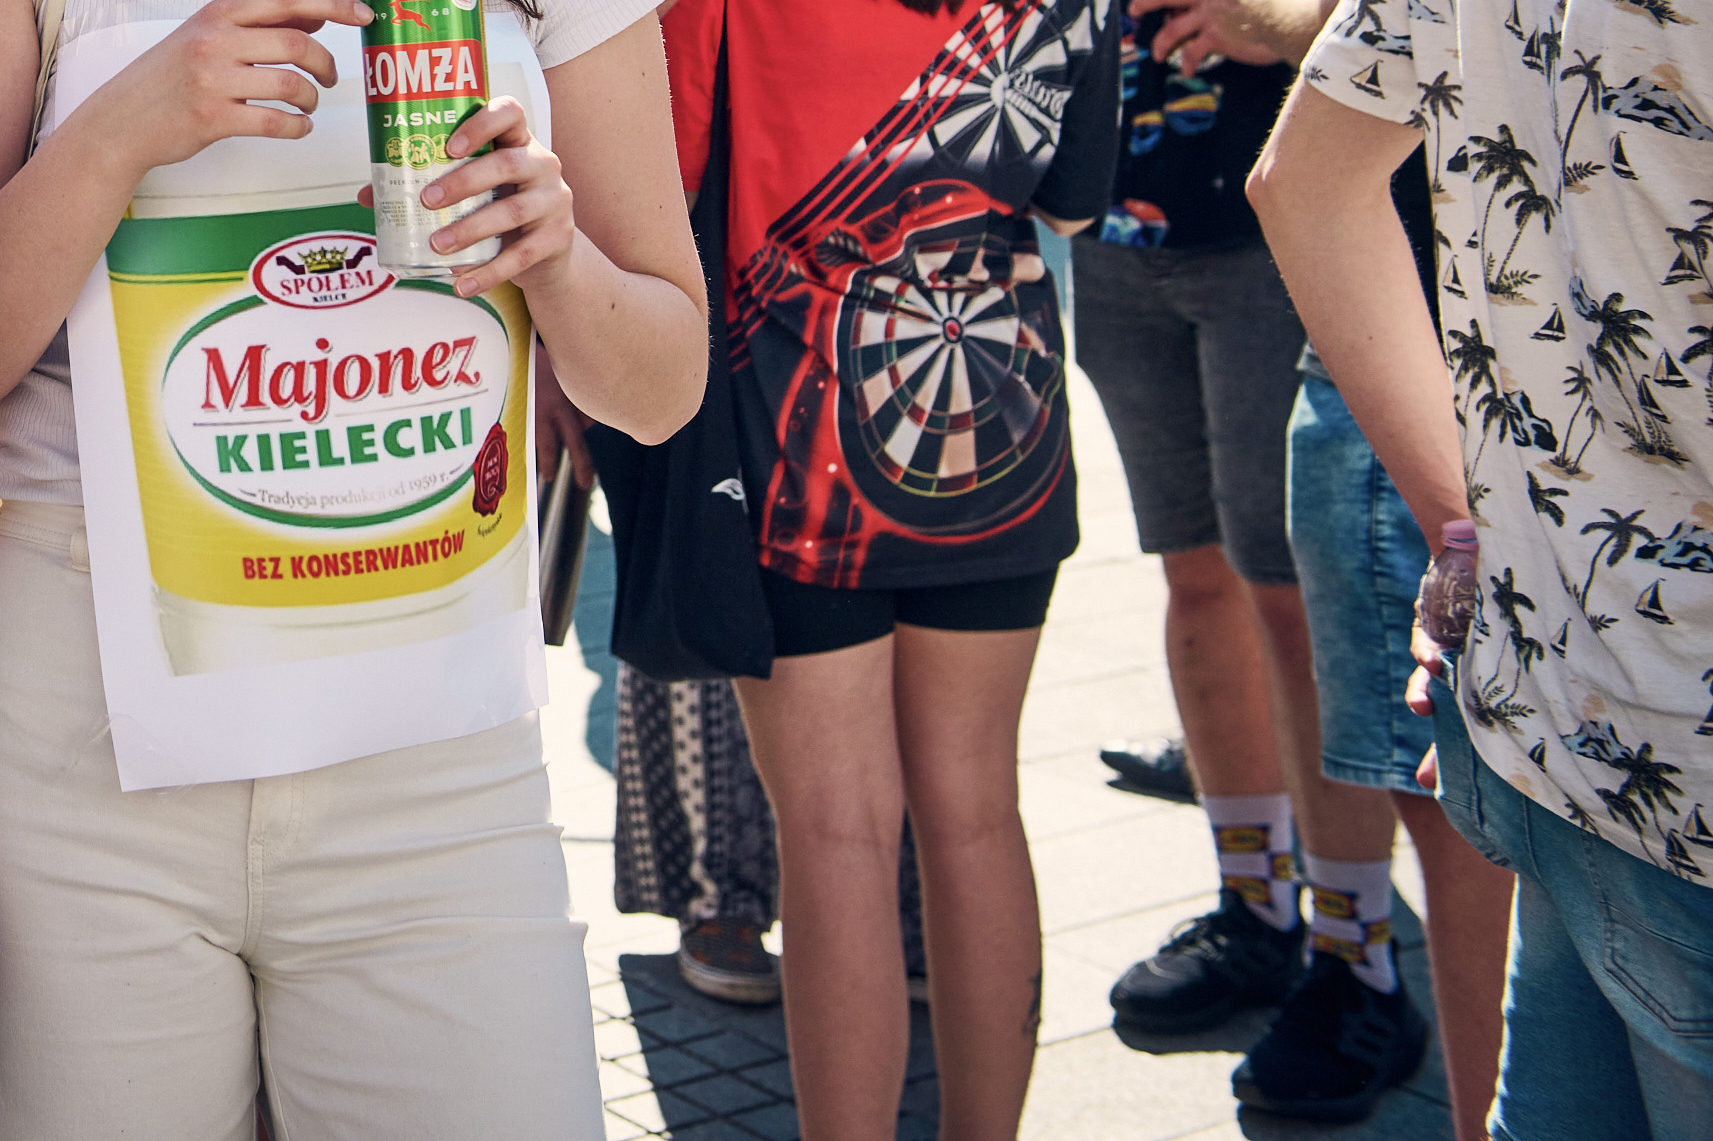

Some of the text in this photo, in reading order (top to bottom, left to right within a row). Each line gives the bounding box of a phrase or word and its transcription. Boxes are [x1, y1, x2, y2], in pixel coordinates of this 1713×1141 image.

[383, 110, 457, 128] JASNE
[279, 270, 375, 296] SPOŁEM
[200, 336, 482, 424] Majonez
[215, 406, 473, 474] KIELECKI
[258, 489, 317, 509] Tradycja
[389, 482, 406, 498] od
[409, 475, 437, 492] 1959
[242, 530, 466, 580] BEZ KONSERWANTÓW
